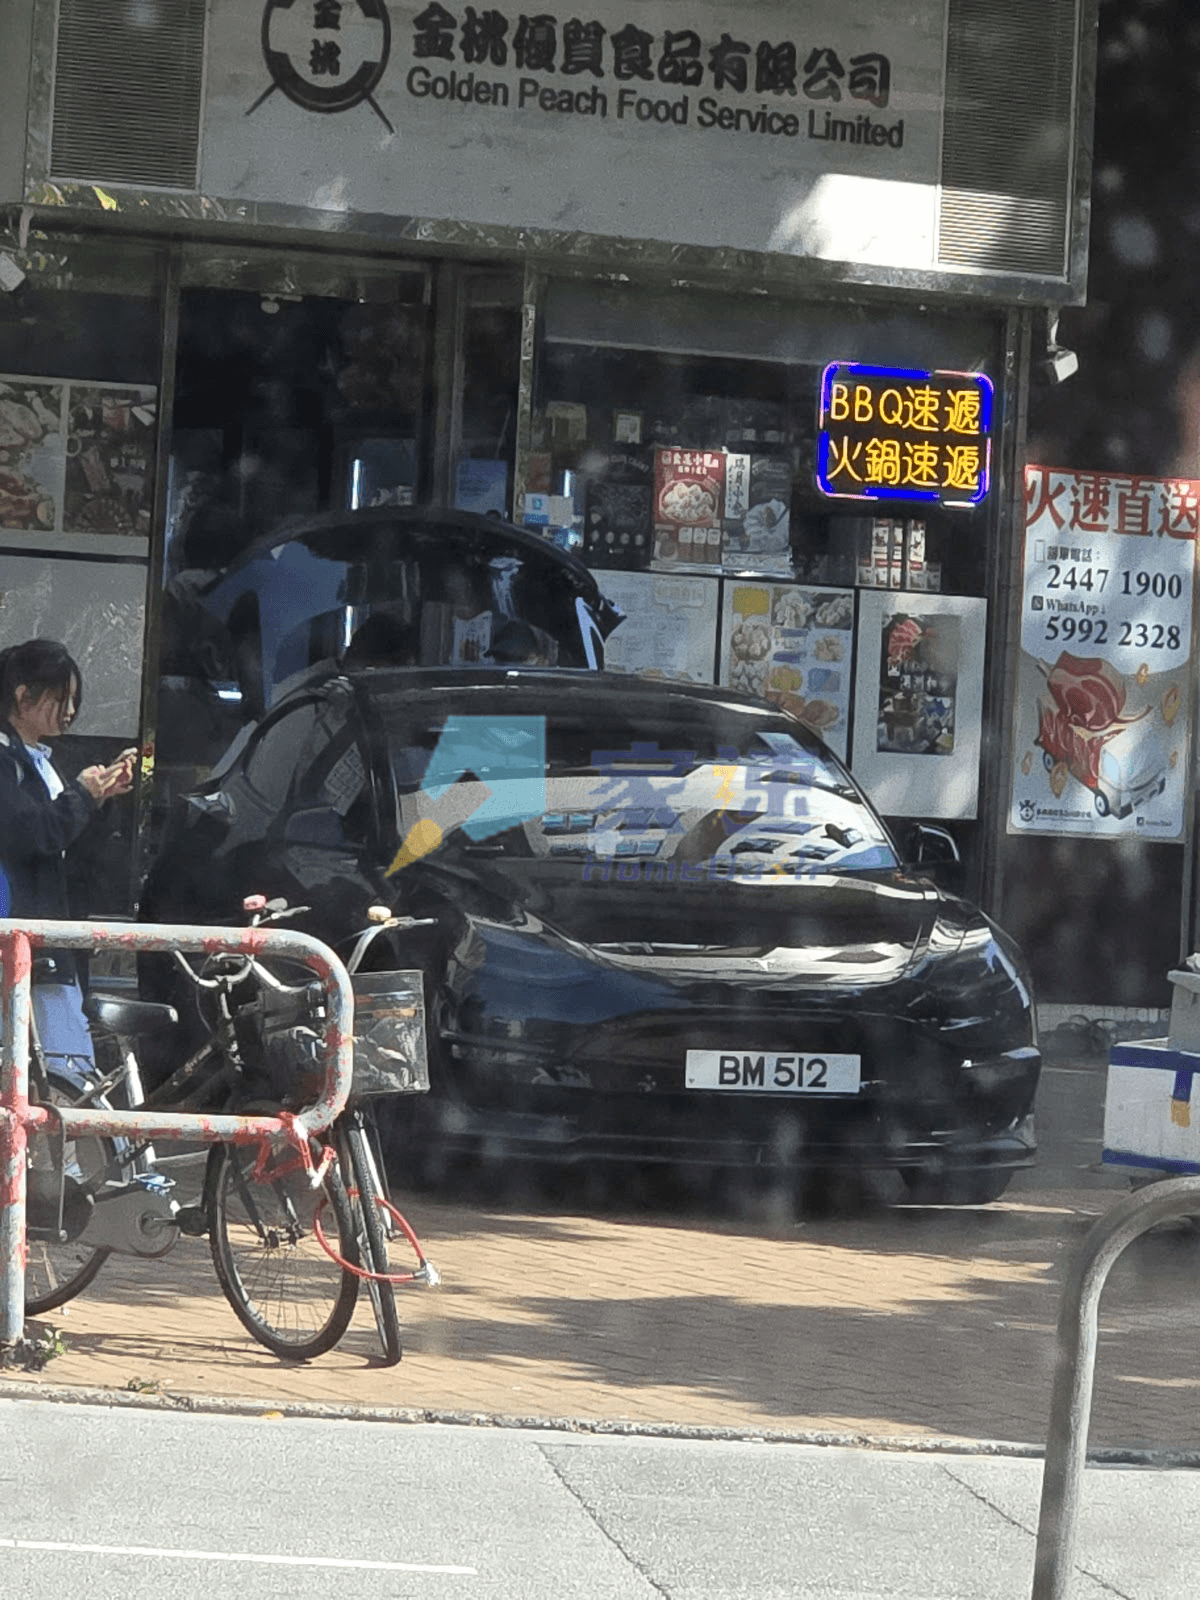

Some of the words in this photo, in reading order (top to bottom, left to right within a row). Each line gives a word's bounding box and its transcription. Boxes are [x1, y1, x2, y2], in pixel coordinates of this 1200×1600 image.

[412, 1, 891, 108] 金桃優質食品有限公司
[406, 65, 509, 107] Golden
[518, 77, 608, 118] Peach
[616, 88, 689, 125] Food
[697, 96, 800, 137] Service
[808, 109, 904, 149] Limited
[826, 435, 980, 490] 火鍋速遞
[1025, 469, 1197, 540] 火速直送
[1046, 564, 1109, 593] 2447
[1121, 570, 1182, 599] 1900
[1045, 614, 1108, 644] 5992
[1118, 621, 1181, 650] 2328
[719, 1056, 765, 1087] BM
[773, 1057, 828, 1088] 512
